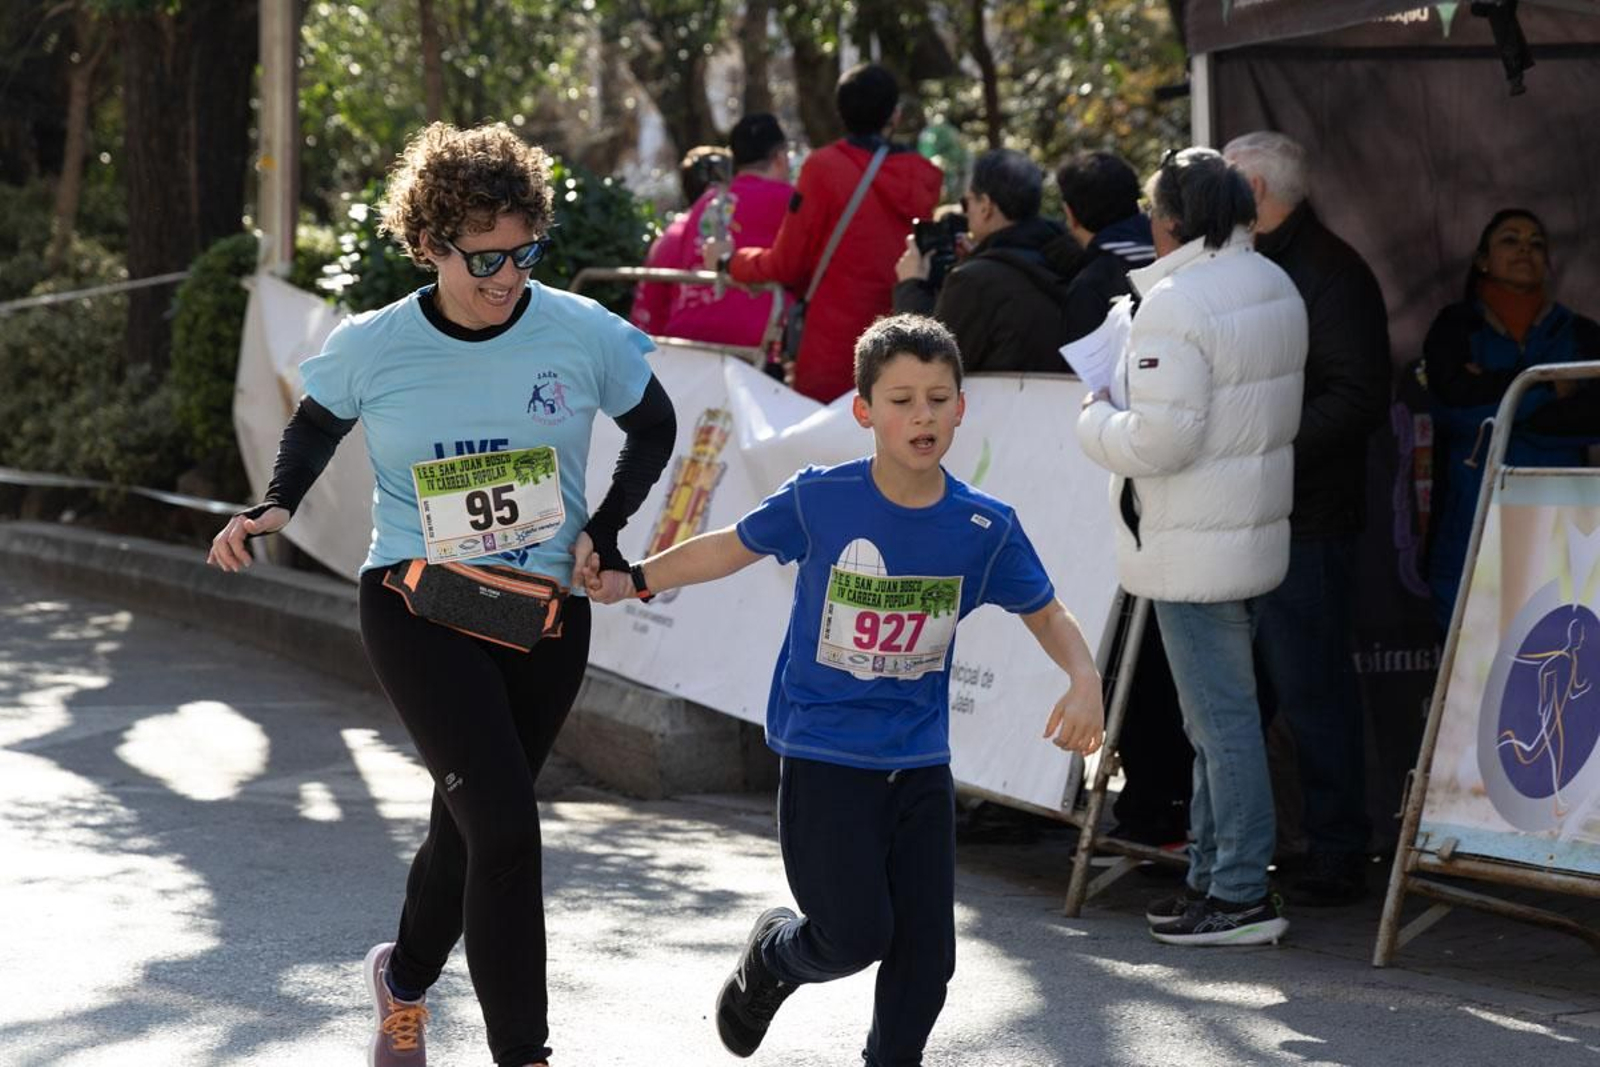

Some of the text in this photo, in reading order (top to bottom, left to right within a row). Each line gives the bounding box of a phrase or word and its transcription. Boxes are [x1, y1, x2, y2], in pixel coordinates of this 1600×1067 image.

[439, 462, 456, 476] SAN
[460, 459, 482, 473] JUAN
[485, 454, 511, 467] BOSCO
[437, 473, 471, 490] CARRERA
[472, 466, 507, 485] POPULAR
[466, 484, 519, 531] 95
[855, 576, 872, 590] SAN
[875, 580, 898, 593] JUAN
[900, 580, 922, 592] BOSCO
[847, 588, 881, 607] CARRERA
[884, 593, 915, 608] POPULAR
[853, 611, 928, 652] 927
